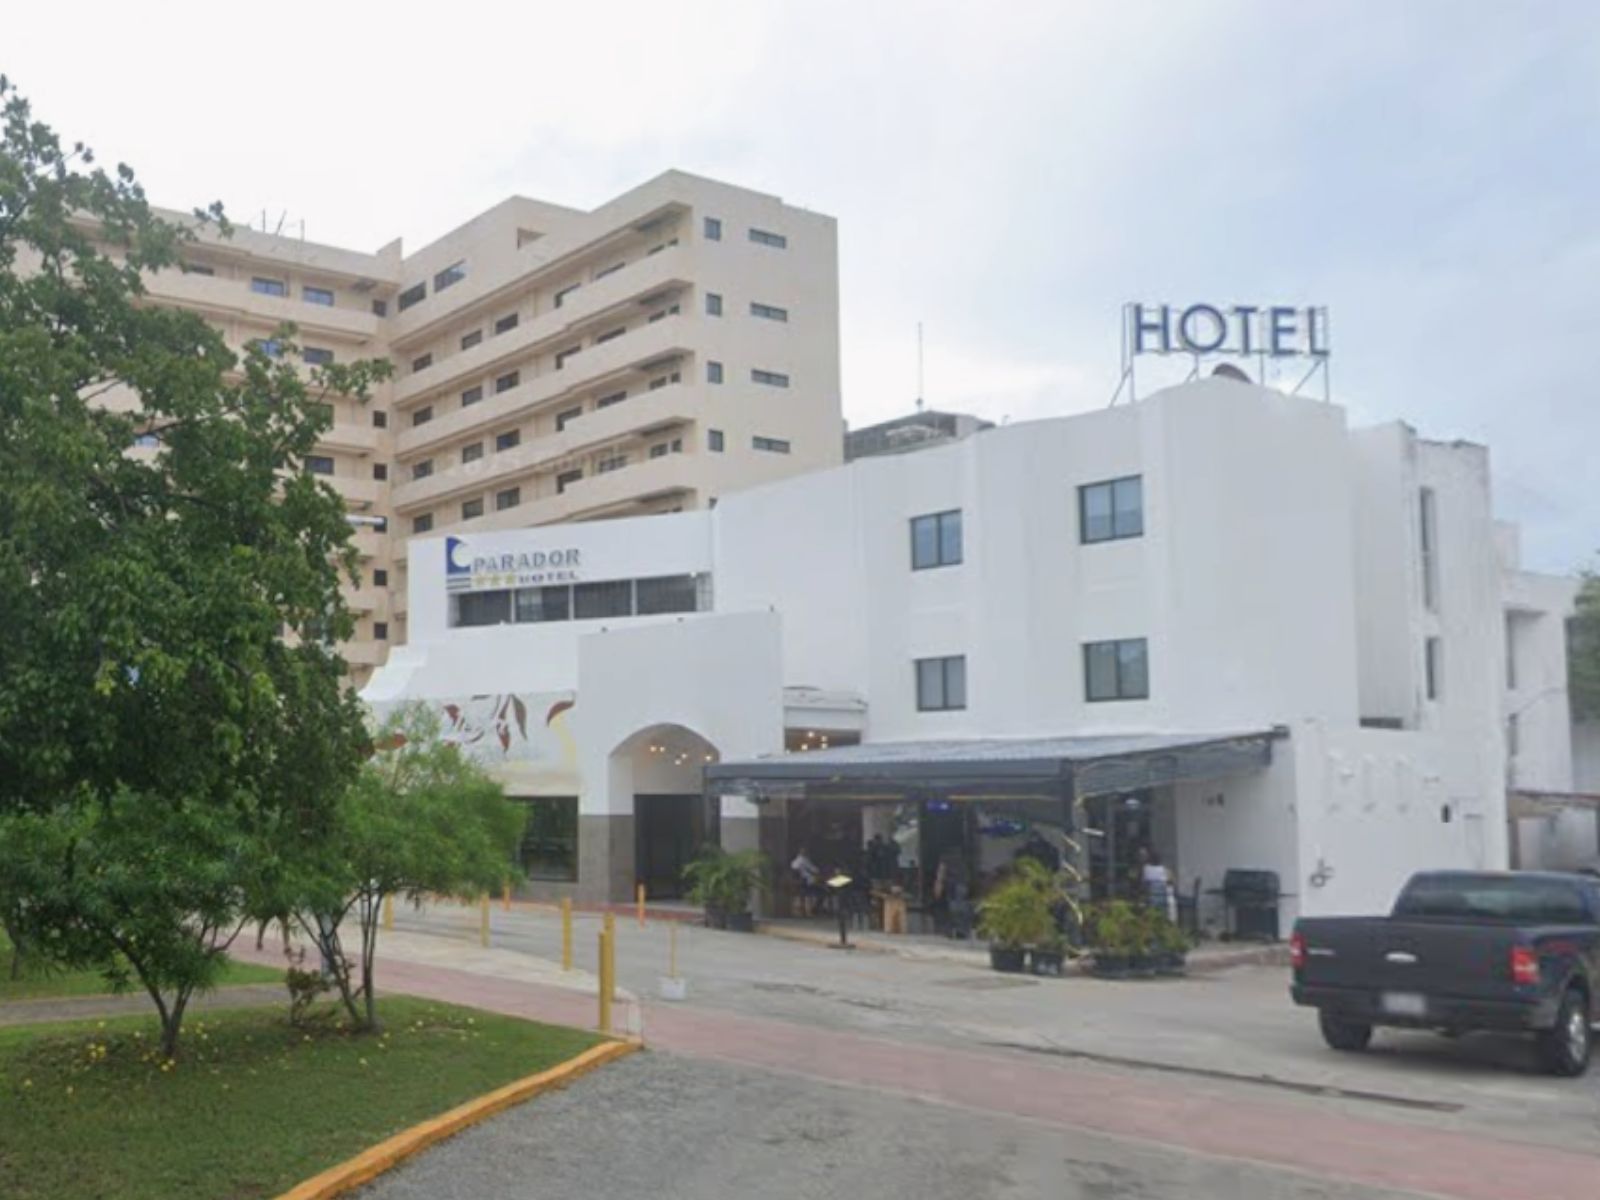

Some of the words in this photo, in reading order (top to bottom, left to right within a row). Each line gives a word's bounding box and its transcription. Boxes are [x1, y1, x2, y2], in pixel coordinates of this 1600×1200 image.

[1134, 303, 1330, 356] HOTEL
[474, 549, 581, 572] PARADOR
[519, 570, 579, 584] HOTEL
